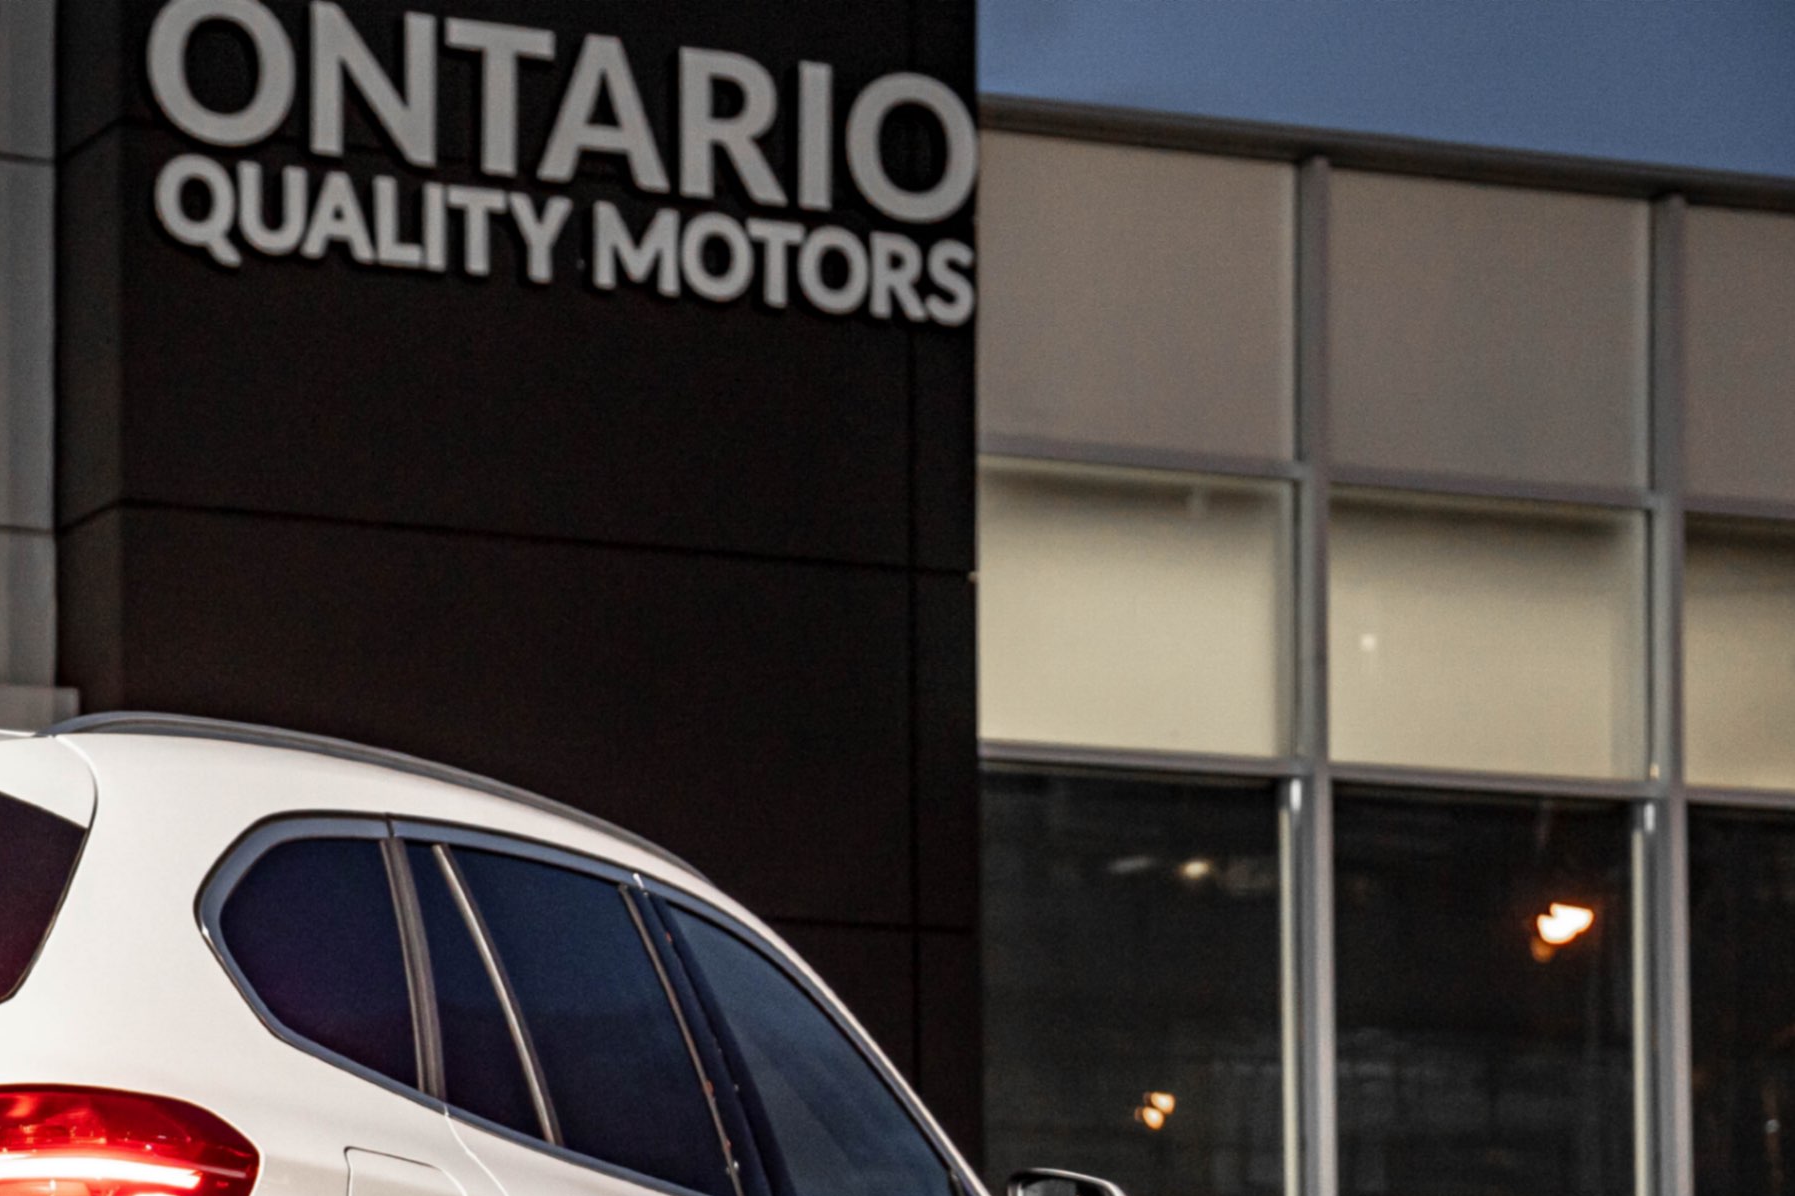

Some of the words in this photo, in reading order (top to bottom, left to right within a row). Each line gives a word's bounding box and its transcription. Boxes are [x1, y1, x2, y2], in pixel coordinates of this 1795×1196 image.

[146, 0, 978, 222] ONTARIO
[155, 154, 572, 283] QUALITY
[594, 200, 974, 325] MOTORS
